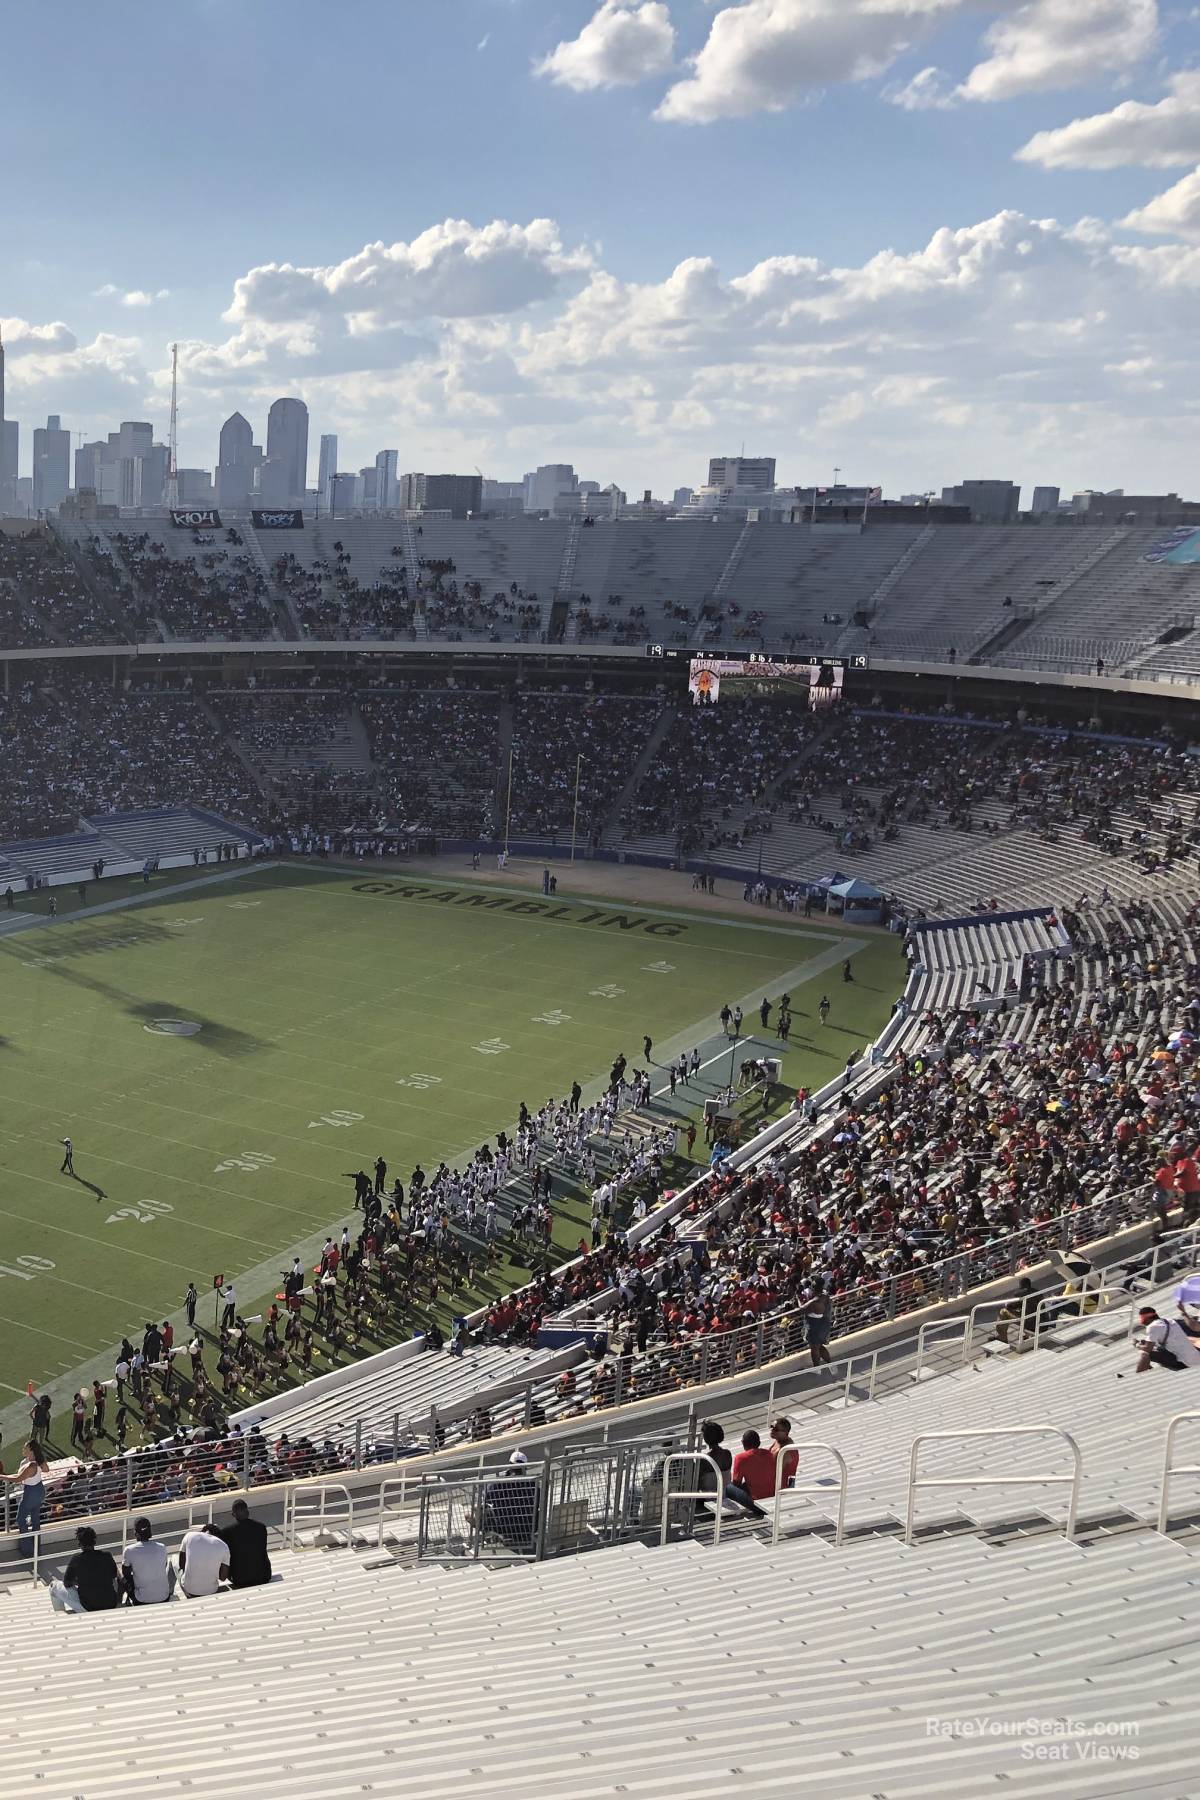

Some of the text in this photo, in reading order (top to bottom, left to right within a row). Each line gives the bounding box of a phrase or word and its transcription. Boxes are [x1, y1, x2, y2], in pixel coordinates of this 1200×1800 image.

[652, 645, 662, 655] 19
[855, 656, 866, 666] 19
[351, 882, 689, 937] GRAMBLING
[529, 1012, 572, 1025] 30
[471, 1040, 511, 1054] 40
[395, 1073, 442, 1089] 50
[320, 1110, 364, 1126] 40
[223, 1151, 276, 1171] 30
[116, 1199, 174, 1223] 20
